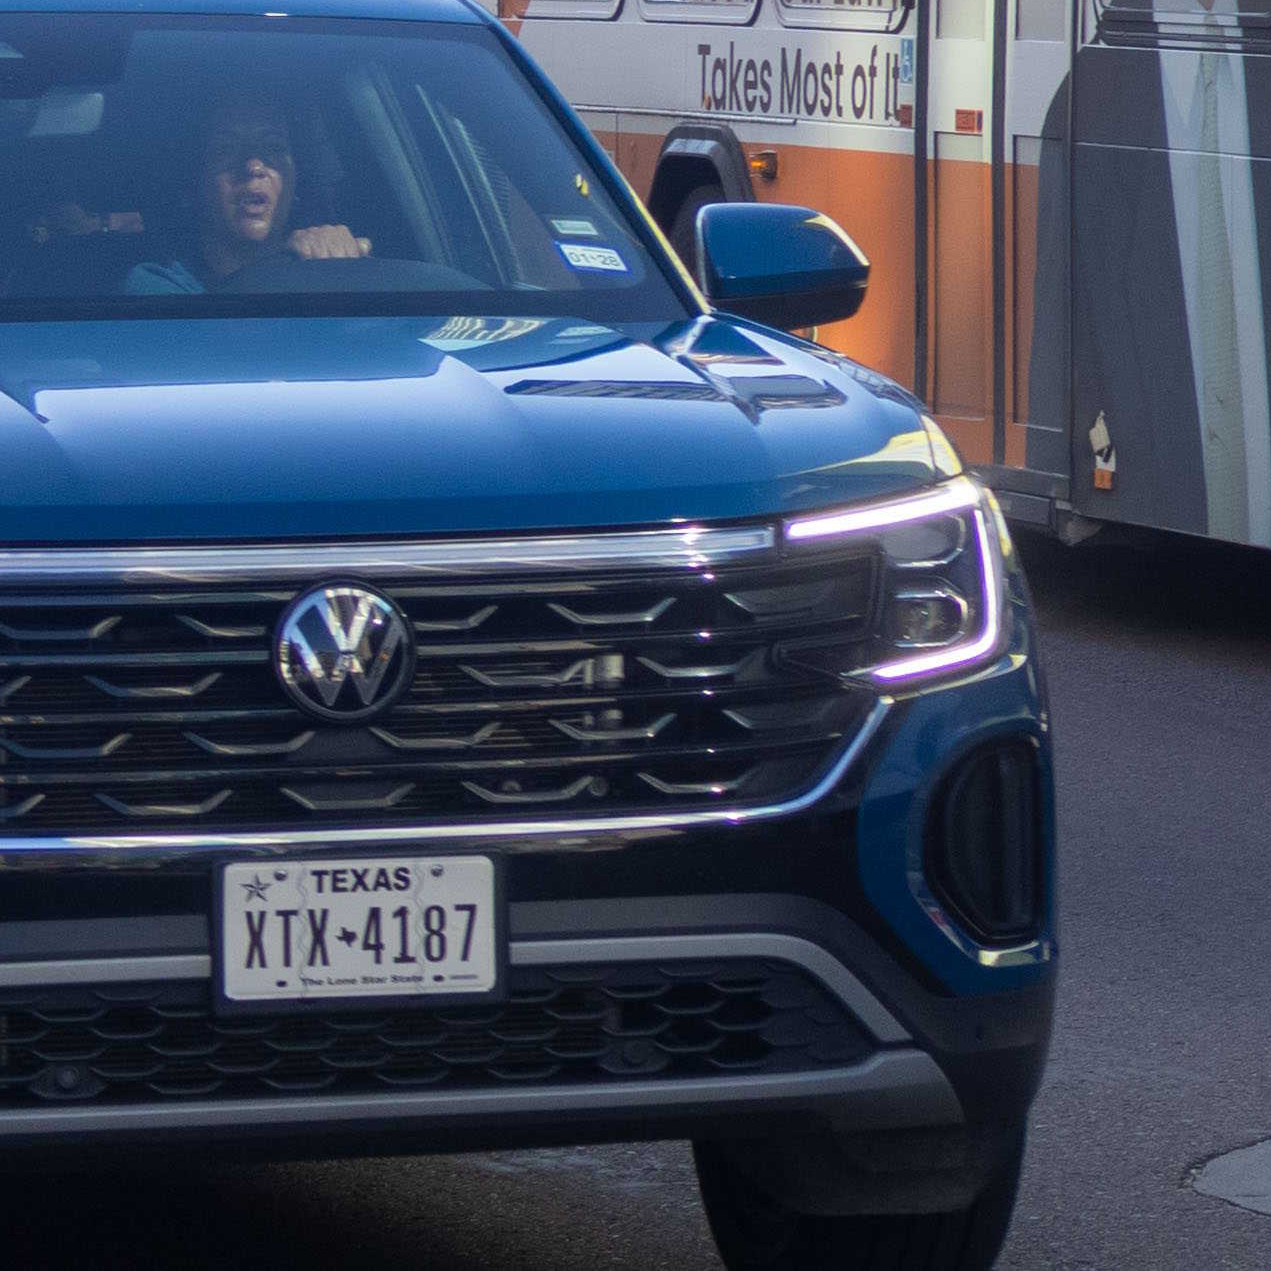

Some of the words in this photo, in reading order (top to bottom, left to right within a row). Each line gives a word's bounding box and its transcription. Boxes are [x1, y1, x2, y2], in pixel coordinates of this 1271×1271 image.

[698, 41, 773, 112] Takes
[780, 47, 845, 118] Most
[851, 44, 878, 120] of
[311, 866, 412, 893] TEXAS
